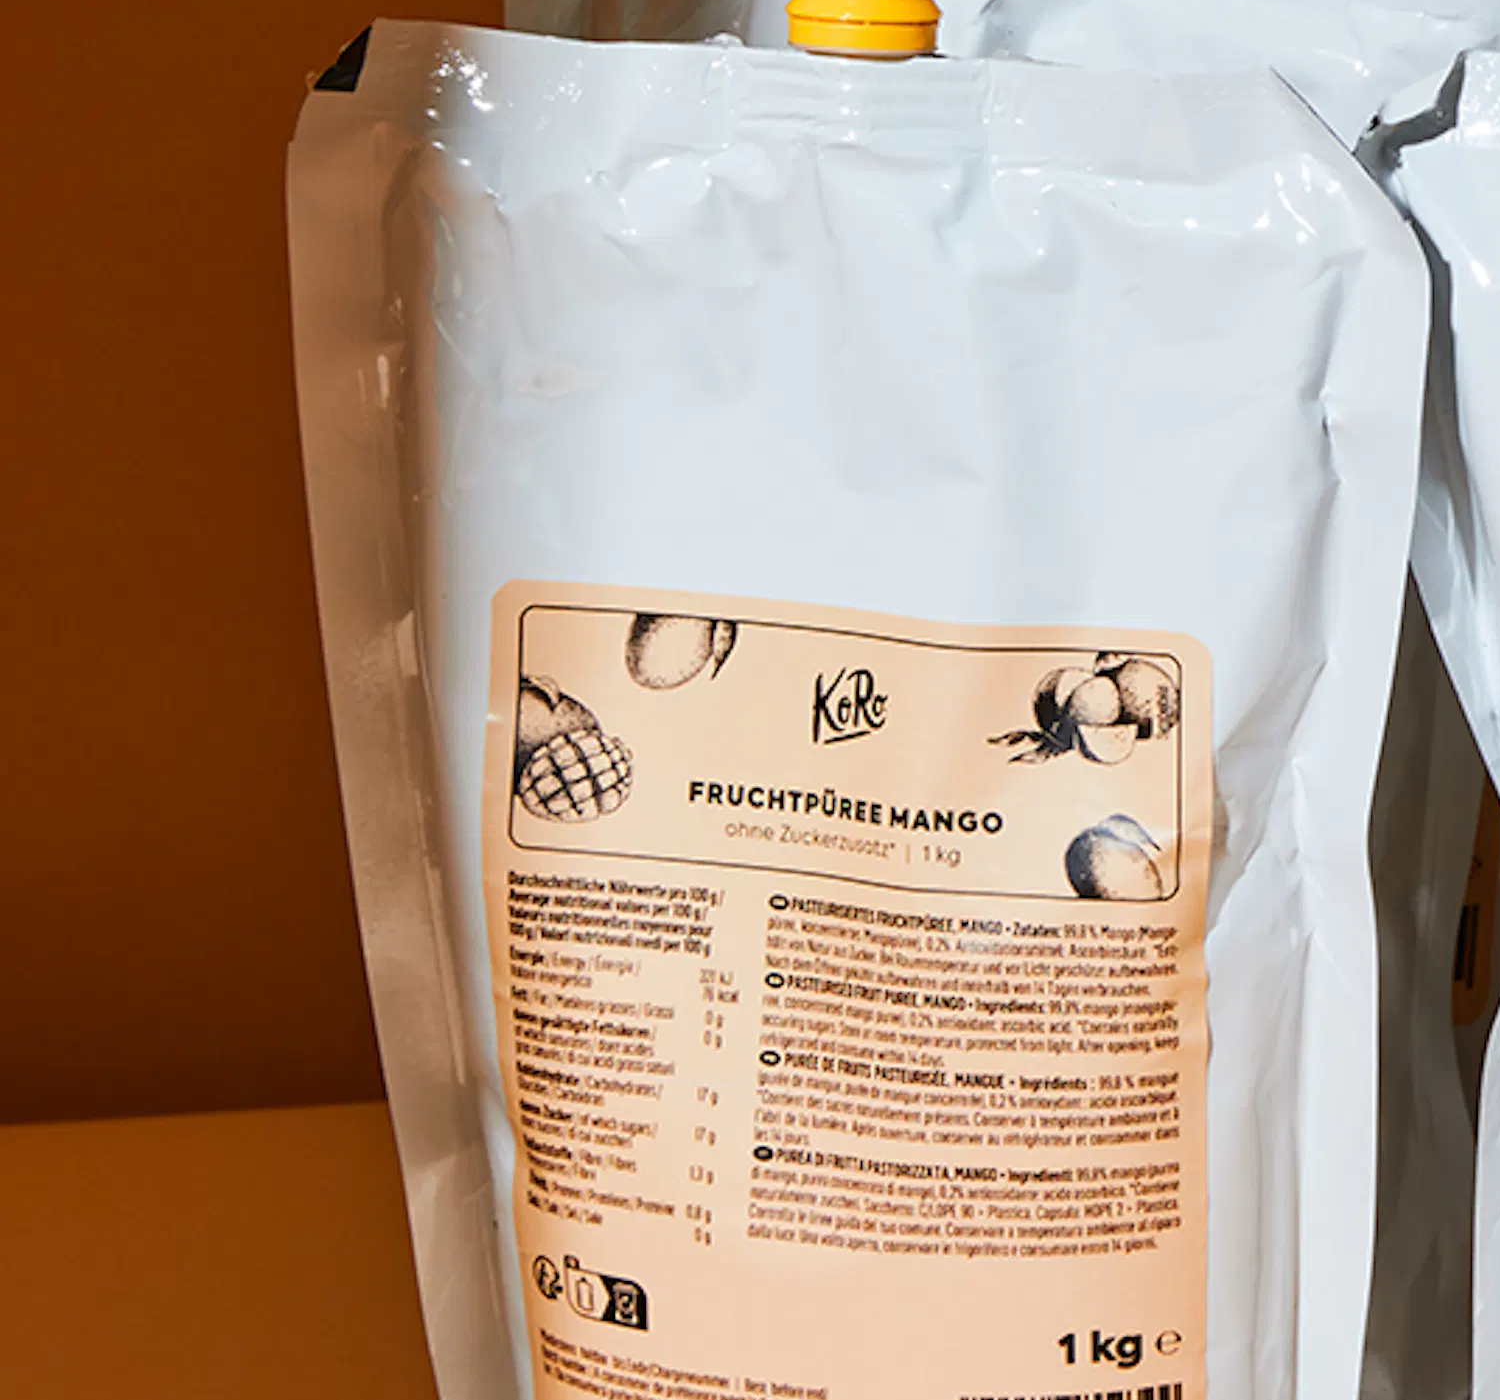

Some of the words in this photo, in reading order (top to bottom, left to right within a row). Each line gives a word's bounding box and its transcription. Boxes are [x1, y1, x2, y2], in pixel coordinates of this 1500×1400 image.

[813, 668, 888, 744] KoRo
[690, 781, 882, 825] FRUCHTPÜREE
[890, 806, 1003, 834] MANGO
[724, 823, 774, 841] ohne
[1058, 1332, 1075, 1365] 1
[1090, 1329, 1143, 1370] kg
